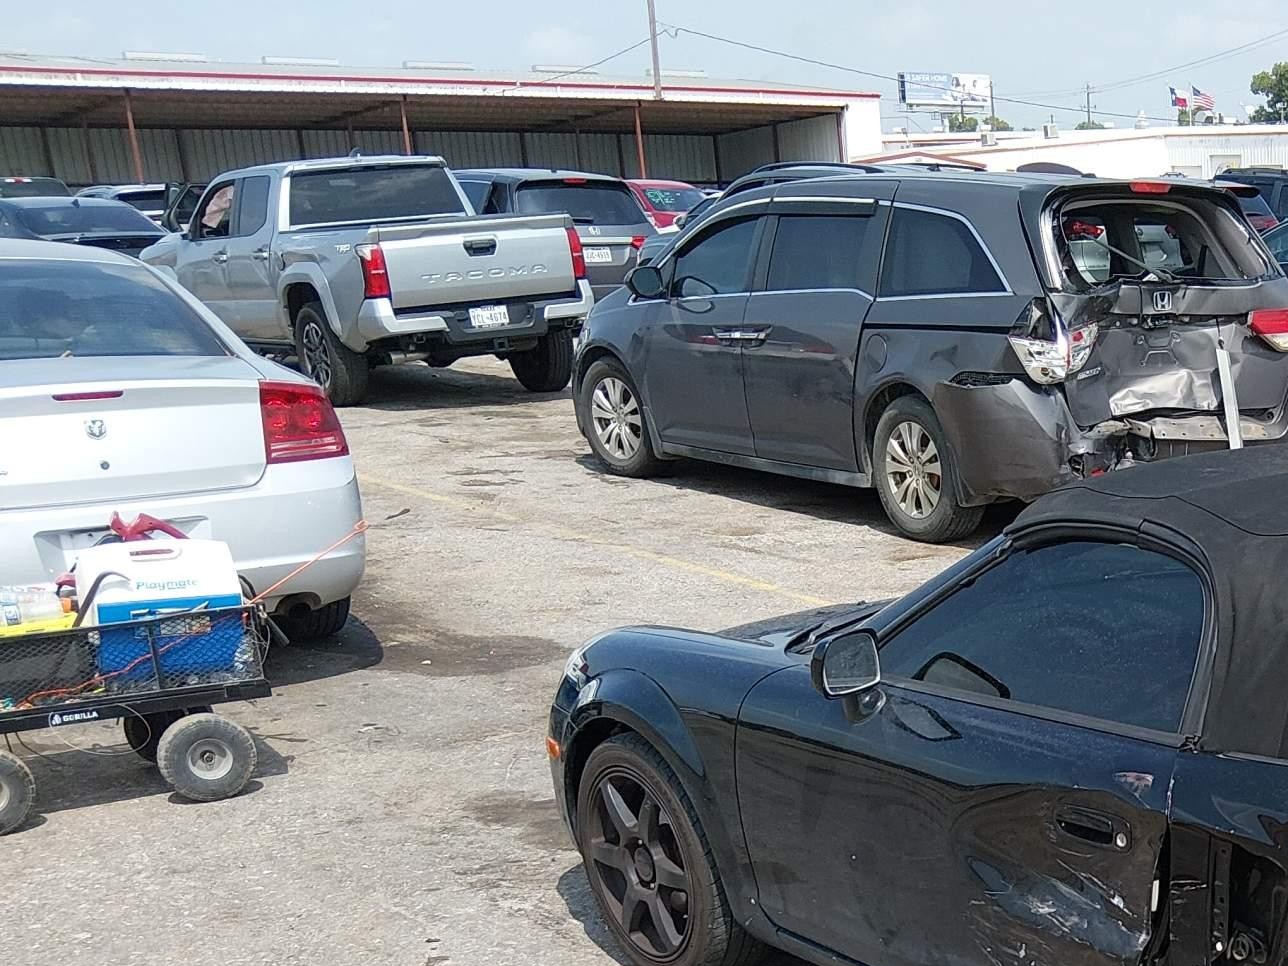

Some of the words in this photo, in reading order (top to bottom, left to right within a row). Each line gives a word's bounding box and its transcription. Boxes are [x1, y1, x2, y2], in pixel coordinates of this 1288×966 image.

[421, 264, 549, 284] TACOMA
[136, 578, 199, 591] Playmate
[62, 710, 99, 723] GORILLA
